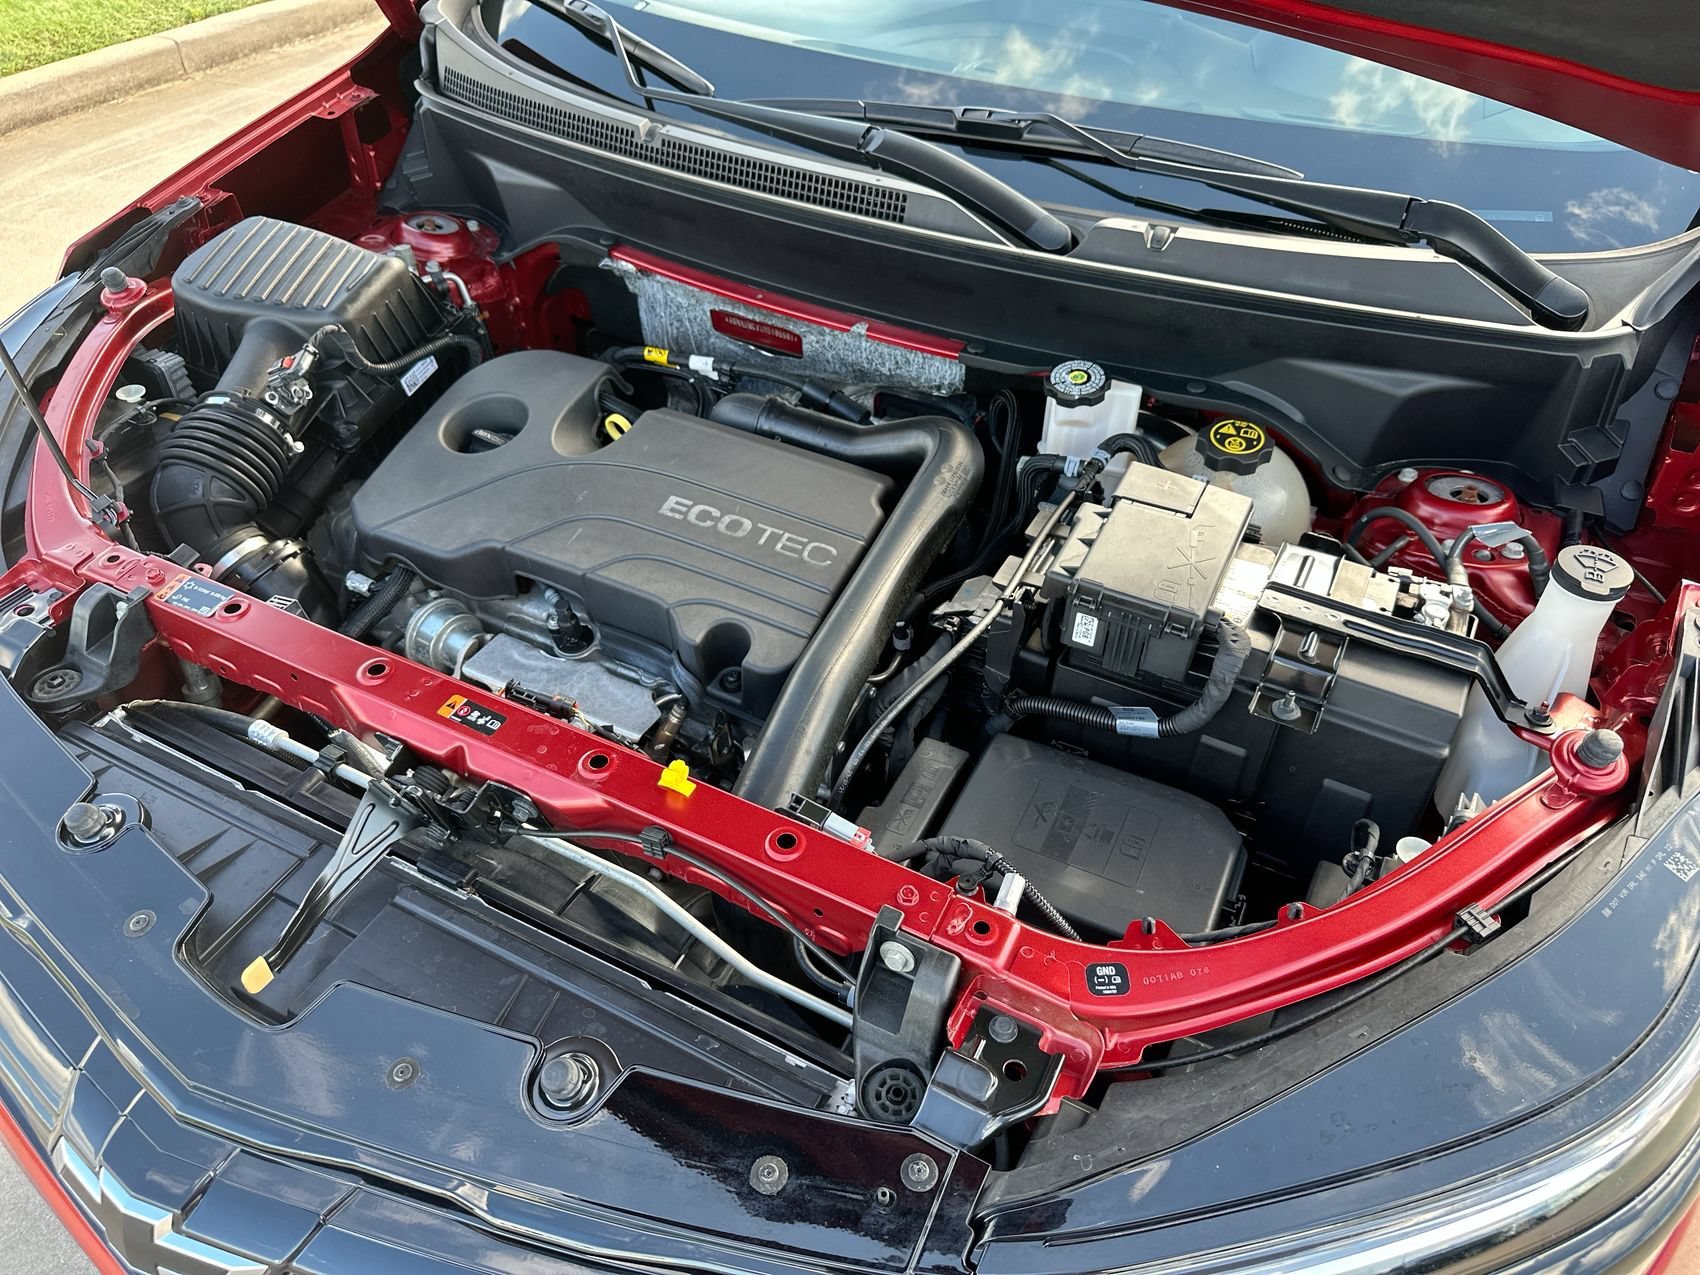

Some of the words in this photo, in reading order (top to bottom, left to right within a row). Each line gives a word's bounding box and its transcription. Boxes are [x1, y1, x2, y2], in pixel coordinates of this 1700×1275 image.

[658, 495, 838, 567] ECOTEC
[1636, 870, 1647, 881] SAE
[1096, 966, 1116, 976] GND
